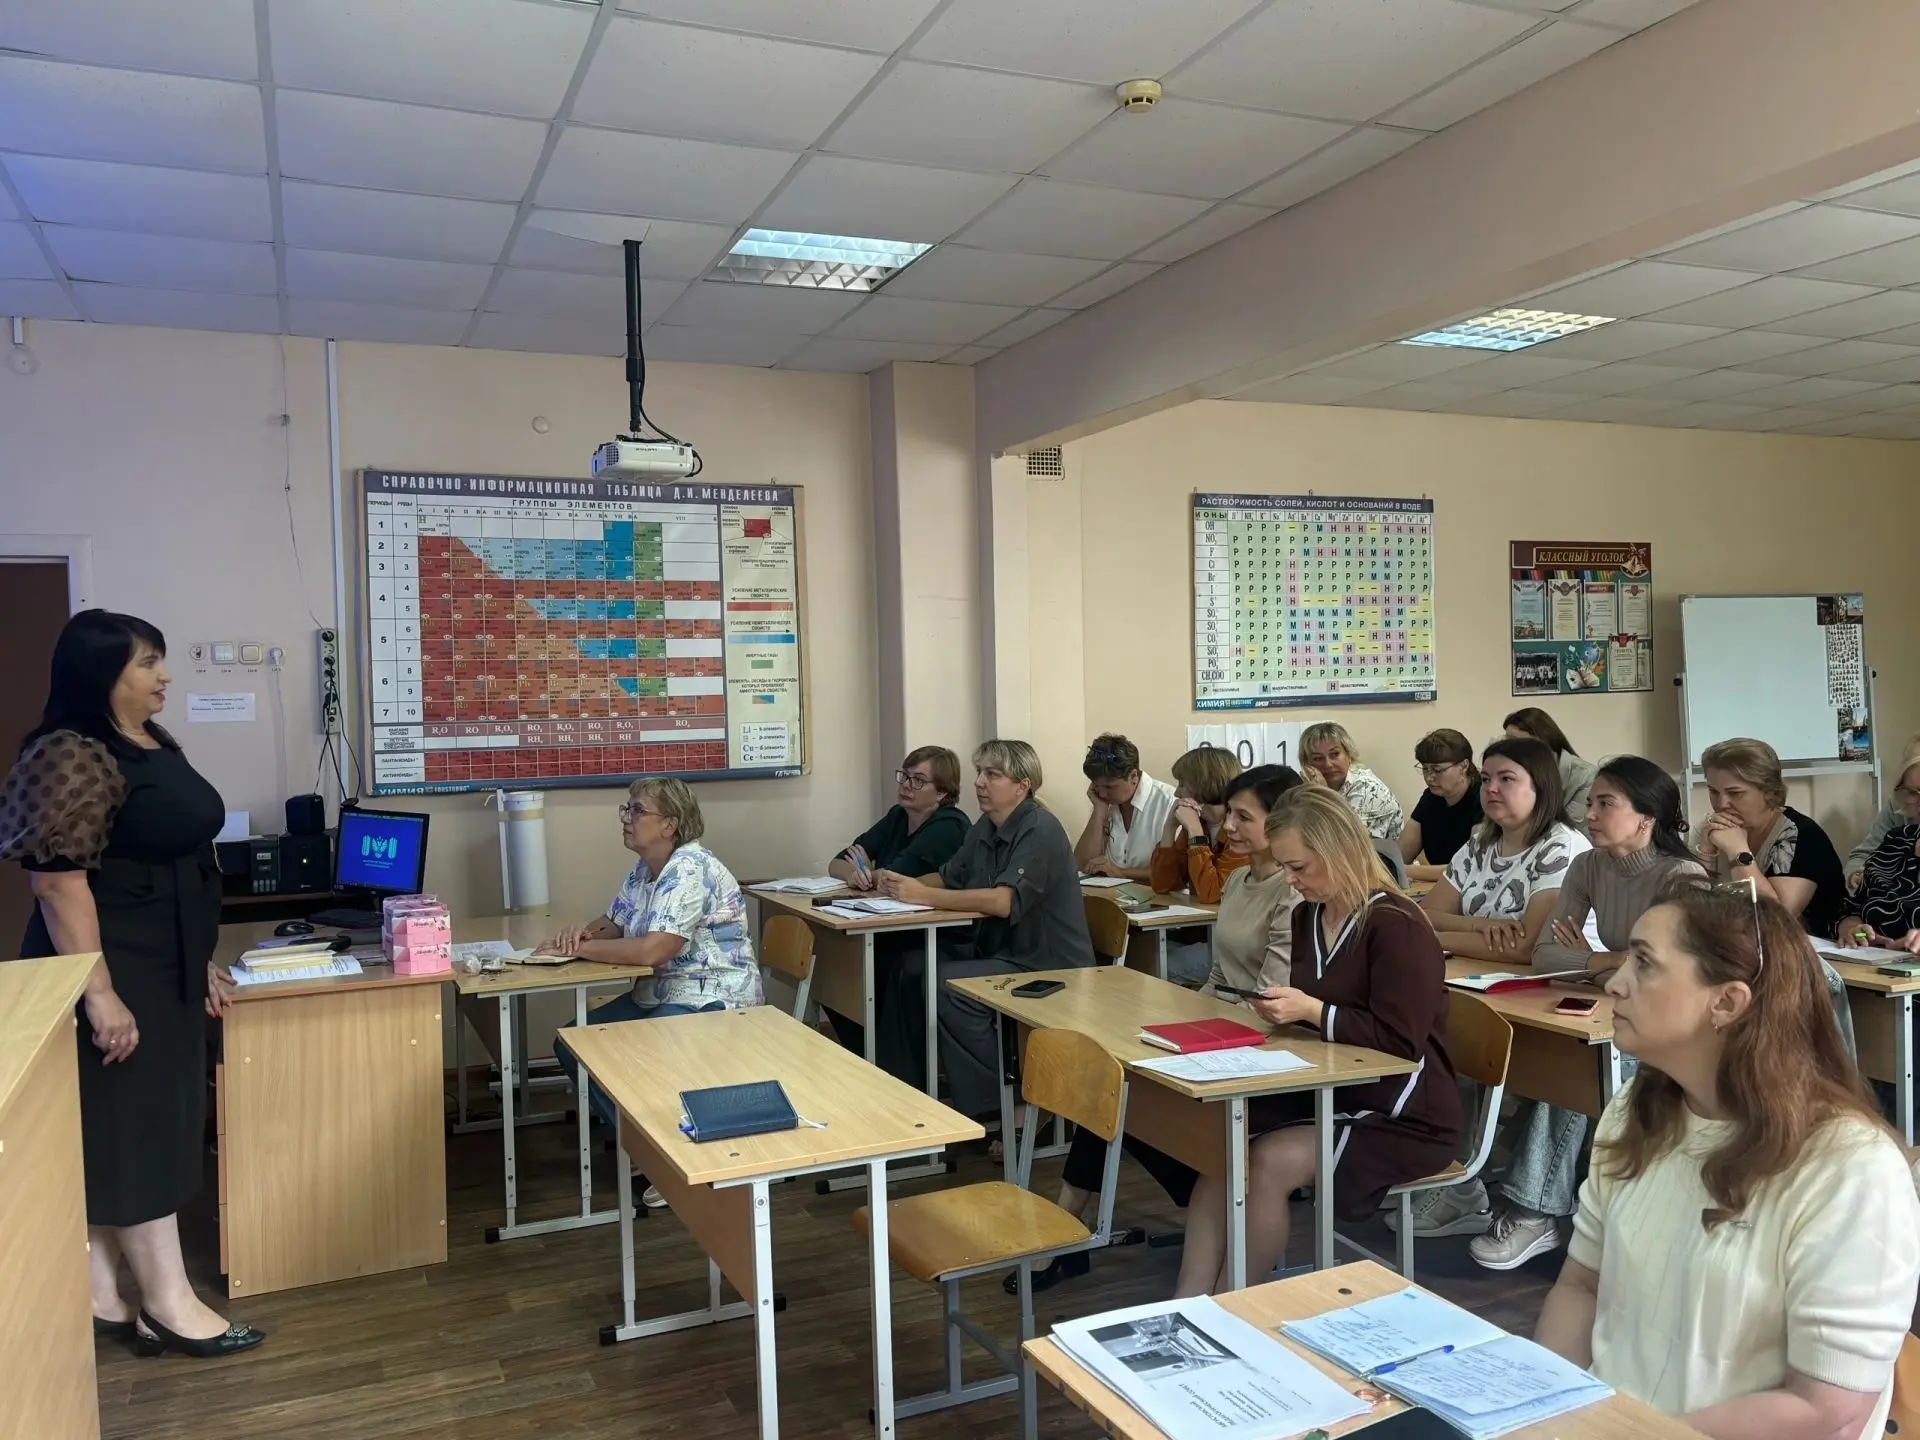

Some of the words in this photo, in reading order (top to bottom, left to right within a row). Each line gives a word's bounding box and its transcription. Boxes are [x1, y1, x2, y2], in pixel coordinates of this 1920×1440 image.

[607, 484, 661, 499] ТАБЛИЦА
[512, 499, 557, 507] ГРУППЫ
[567, 501, 632, 510] ЭЛЕМЕНТОВ
[1201, 497, 1272, 506] РАСТВОРИМОСТЬ
[1306, 500, 1337, 508] КИСЛОТ
[1346, 501, 1394, 509] ОСНОВАНИЙ
[1402, 502, 1422, 511] ВОДЕ
[1195, 511, 1227, 519] ИОНЫ
[378, 542, 384, 550] 2
[403, 542, 408, 550] 2
[1539, 549, 1589, 562] КЛАССНЫЙ
[1591, 551, 1625, 562] УГОЛОК
[378, 563, 385, 571] 3
[404, 563, 409, 571] 3
[404, 584, 410, 592] 4
[379, 594, 386, 602] 4
[405, 625, 411, 633] 6
[380, 636, 387, 644] 5
[406, 646, 411, 654] 7
[407, 667, 412, 675] 8
[381, 678, 388, 686] 6
[1196, 700, 1225, 708] ХИМИЯ
[383, 709, 389, 717] 7
[406, 708, 416, 716] 10
